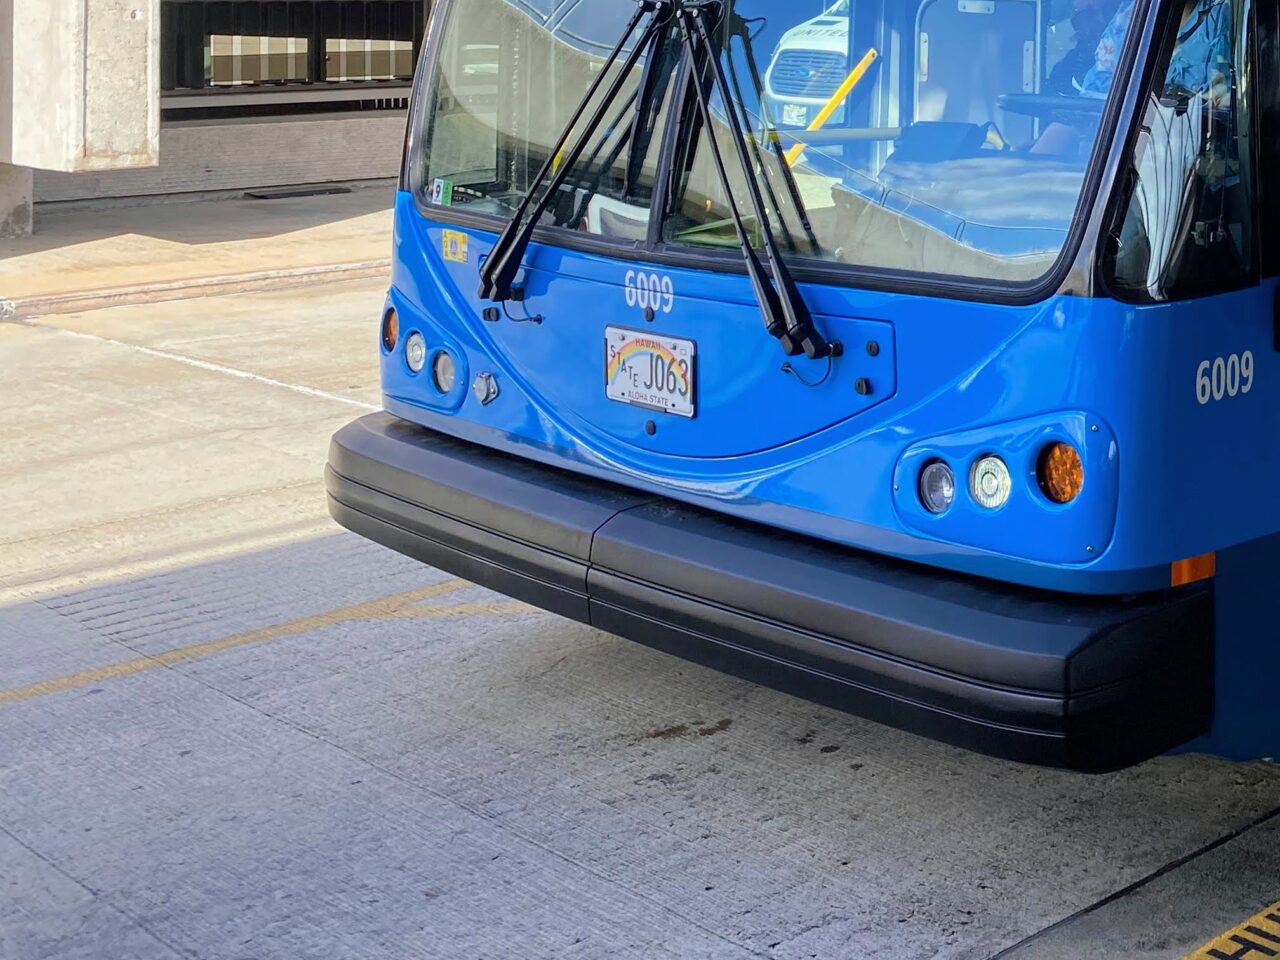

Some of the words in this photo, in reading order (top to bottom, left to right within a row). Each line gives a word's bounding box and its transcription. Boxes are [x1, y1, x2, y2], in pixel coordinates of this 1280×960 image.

[625, 269, 673, 313] 6009
[635, 338, 662, 350] HAWAII
[643, 352, 689, 397] J063
[1196, 350, 1254, 405] 6009
[627, 390, 648, 402] ALOHA
[649, 393, 669, 407] STATE
